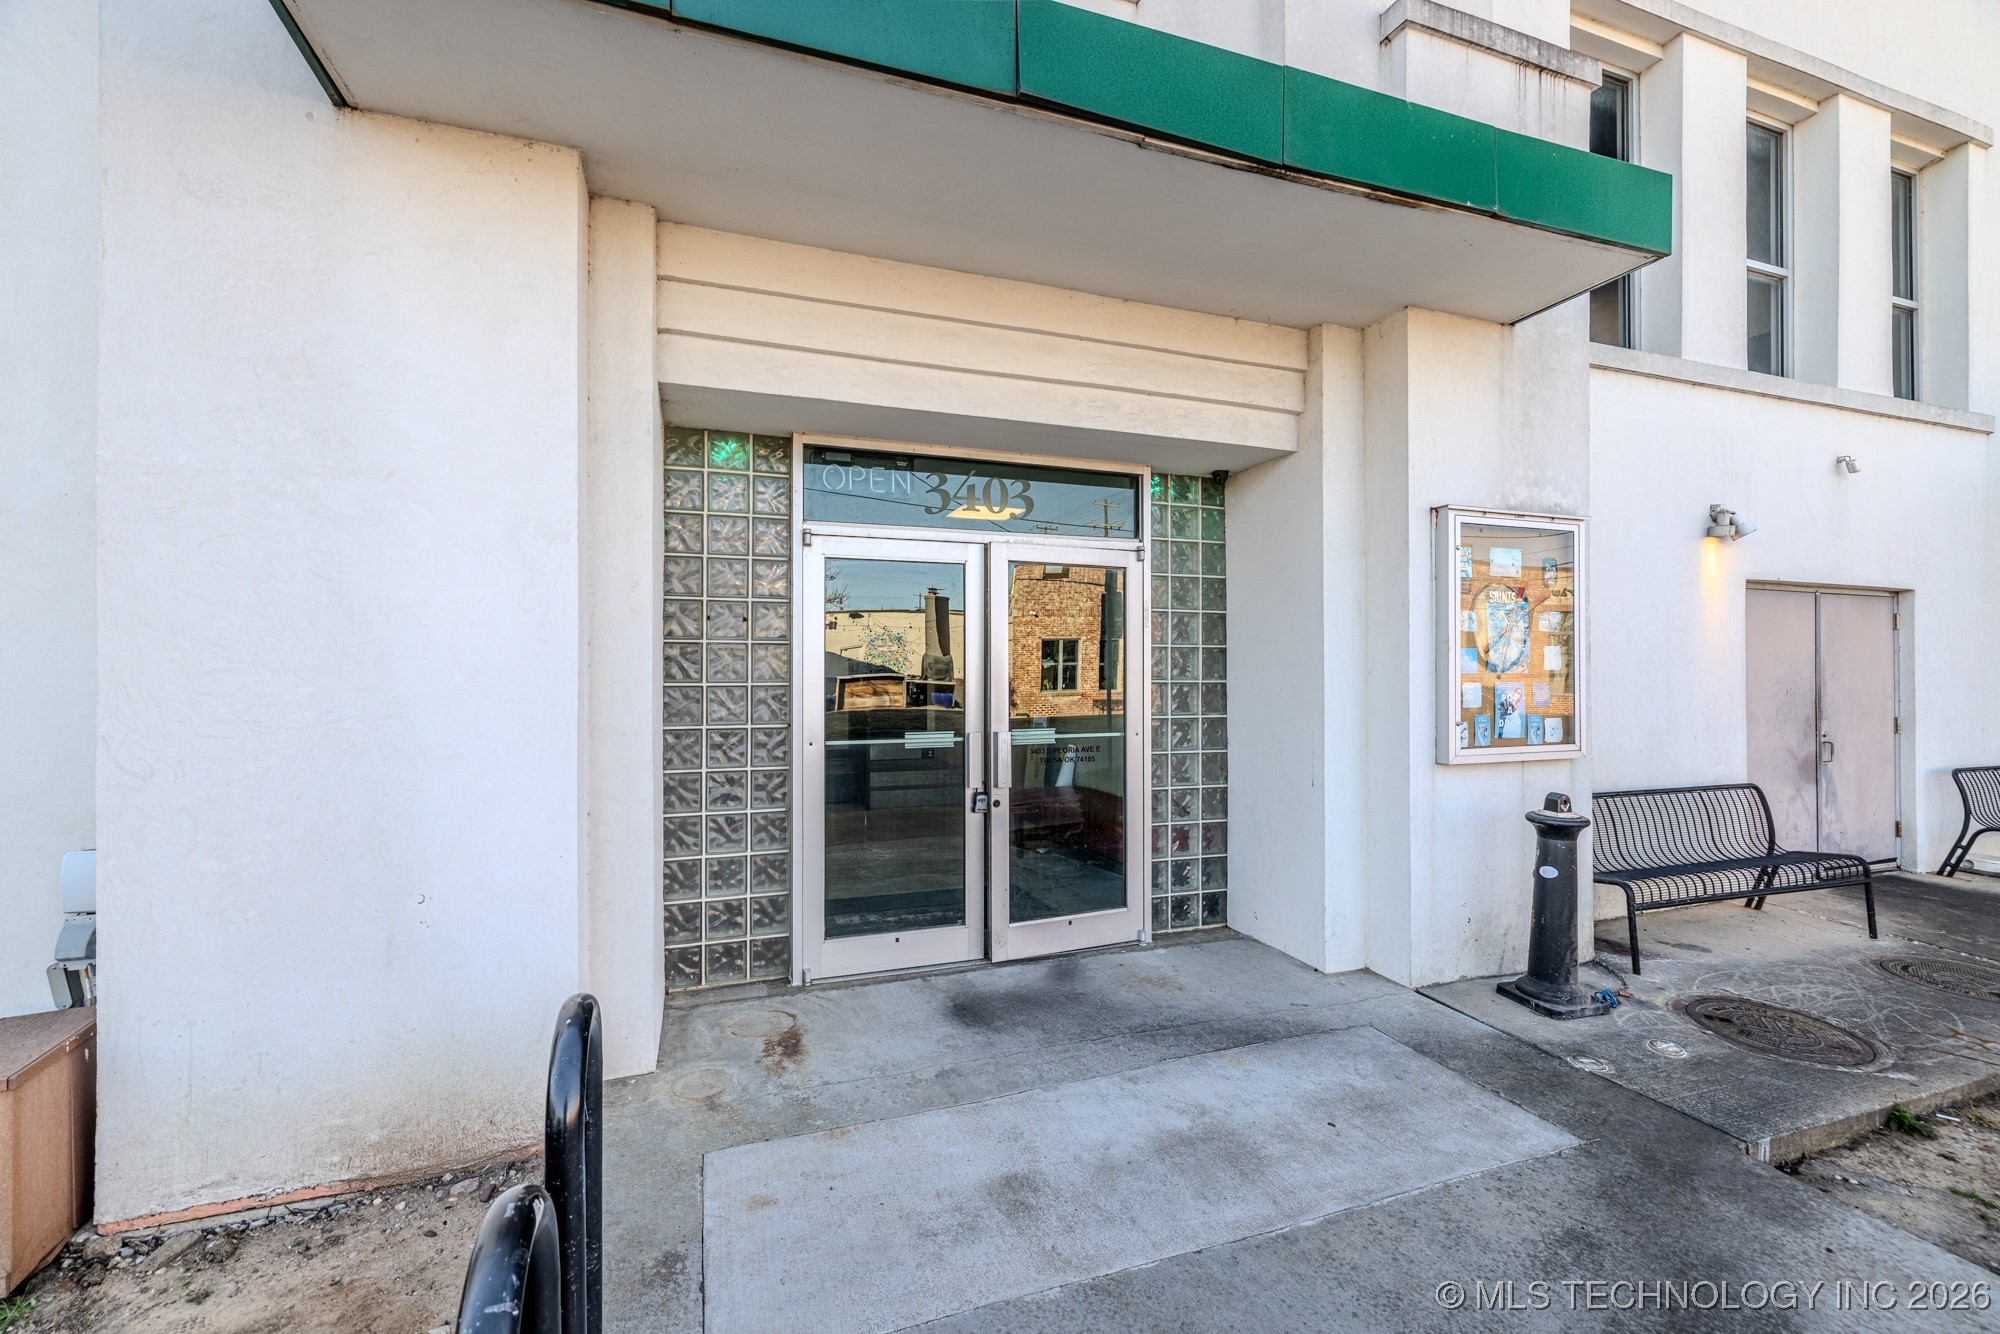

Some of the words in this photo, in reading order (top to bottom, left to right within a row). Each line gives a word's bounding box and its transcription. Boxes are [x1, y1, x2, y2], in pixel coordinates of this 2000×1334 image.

[822, 463, 911, 494] OPEN
[924, 470, 1035, 520] 3403
[1489, 591, 1516, 603] SAINTS
[1053, 746, 1079, 754] PEORIA
